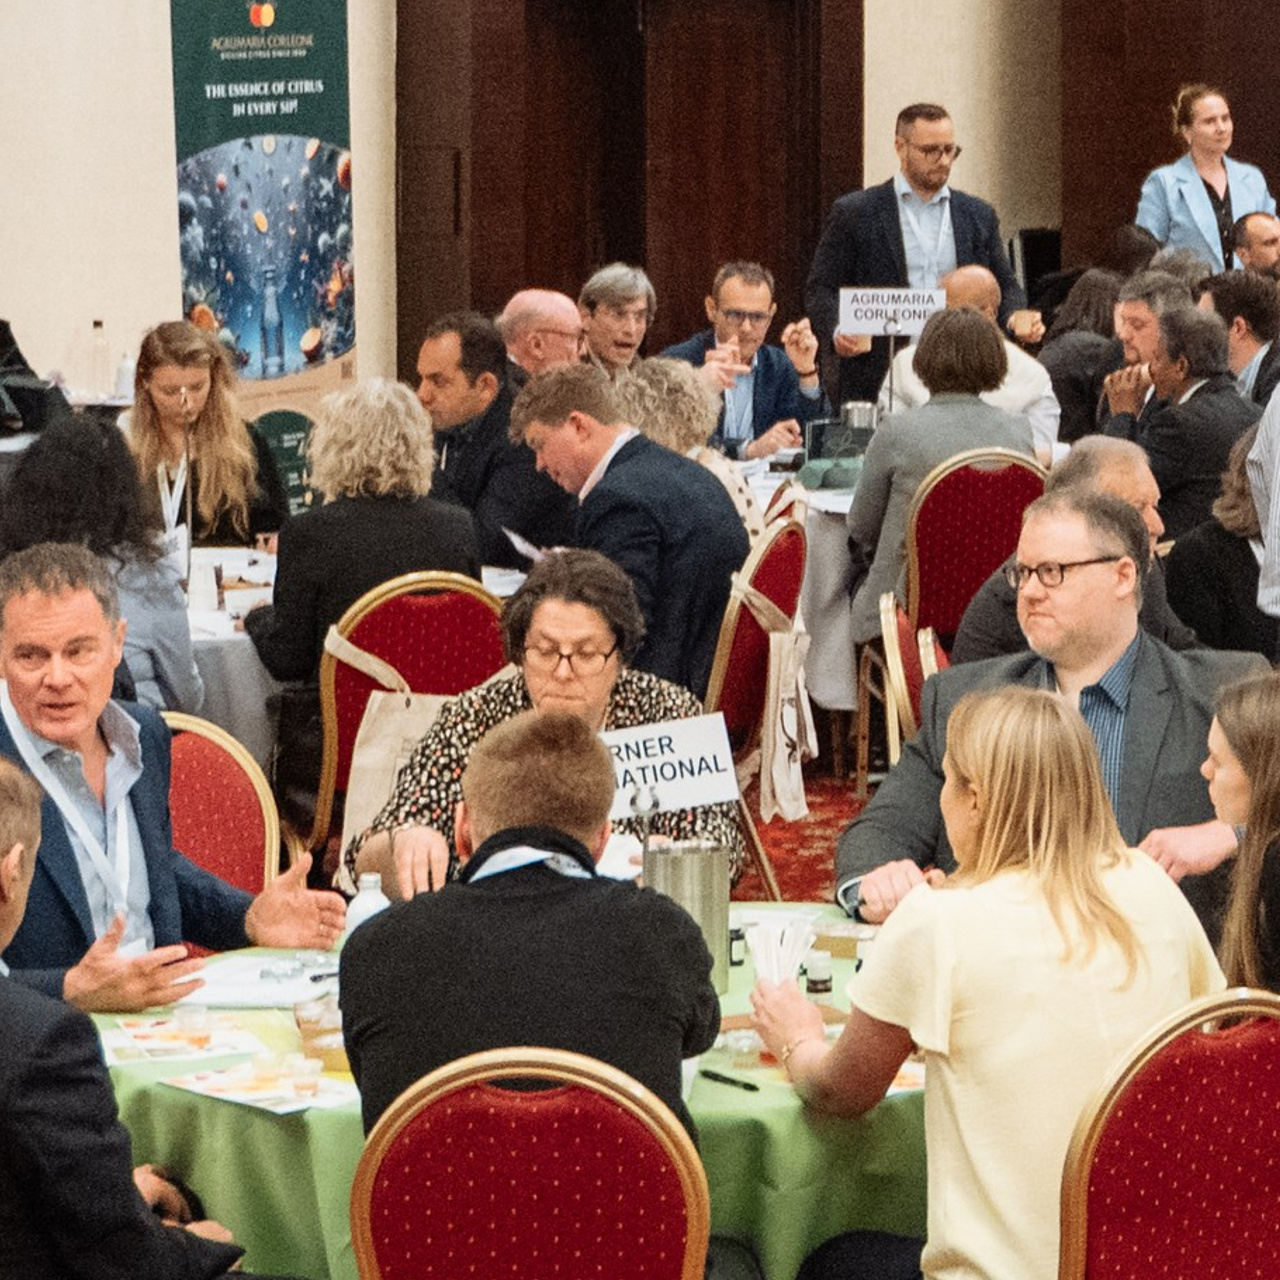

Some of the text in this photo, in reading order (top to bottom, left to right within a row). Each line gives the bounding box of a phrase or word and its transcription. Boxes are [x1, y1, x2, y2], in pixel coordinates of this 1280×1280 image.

[205, 79, 324, 99] THE ESSENCE OF CITRUS
[233, 102, 245, 117] IN
[247, 100, 278, 116] EVERY
[850, 293, 935, 306] AGRUMARIA
